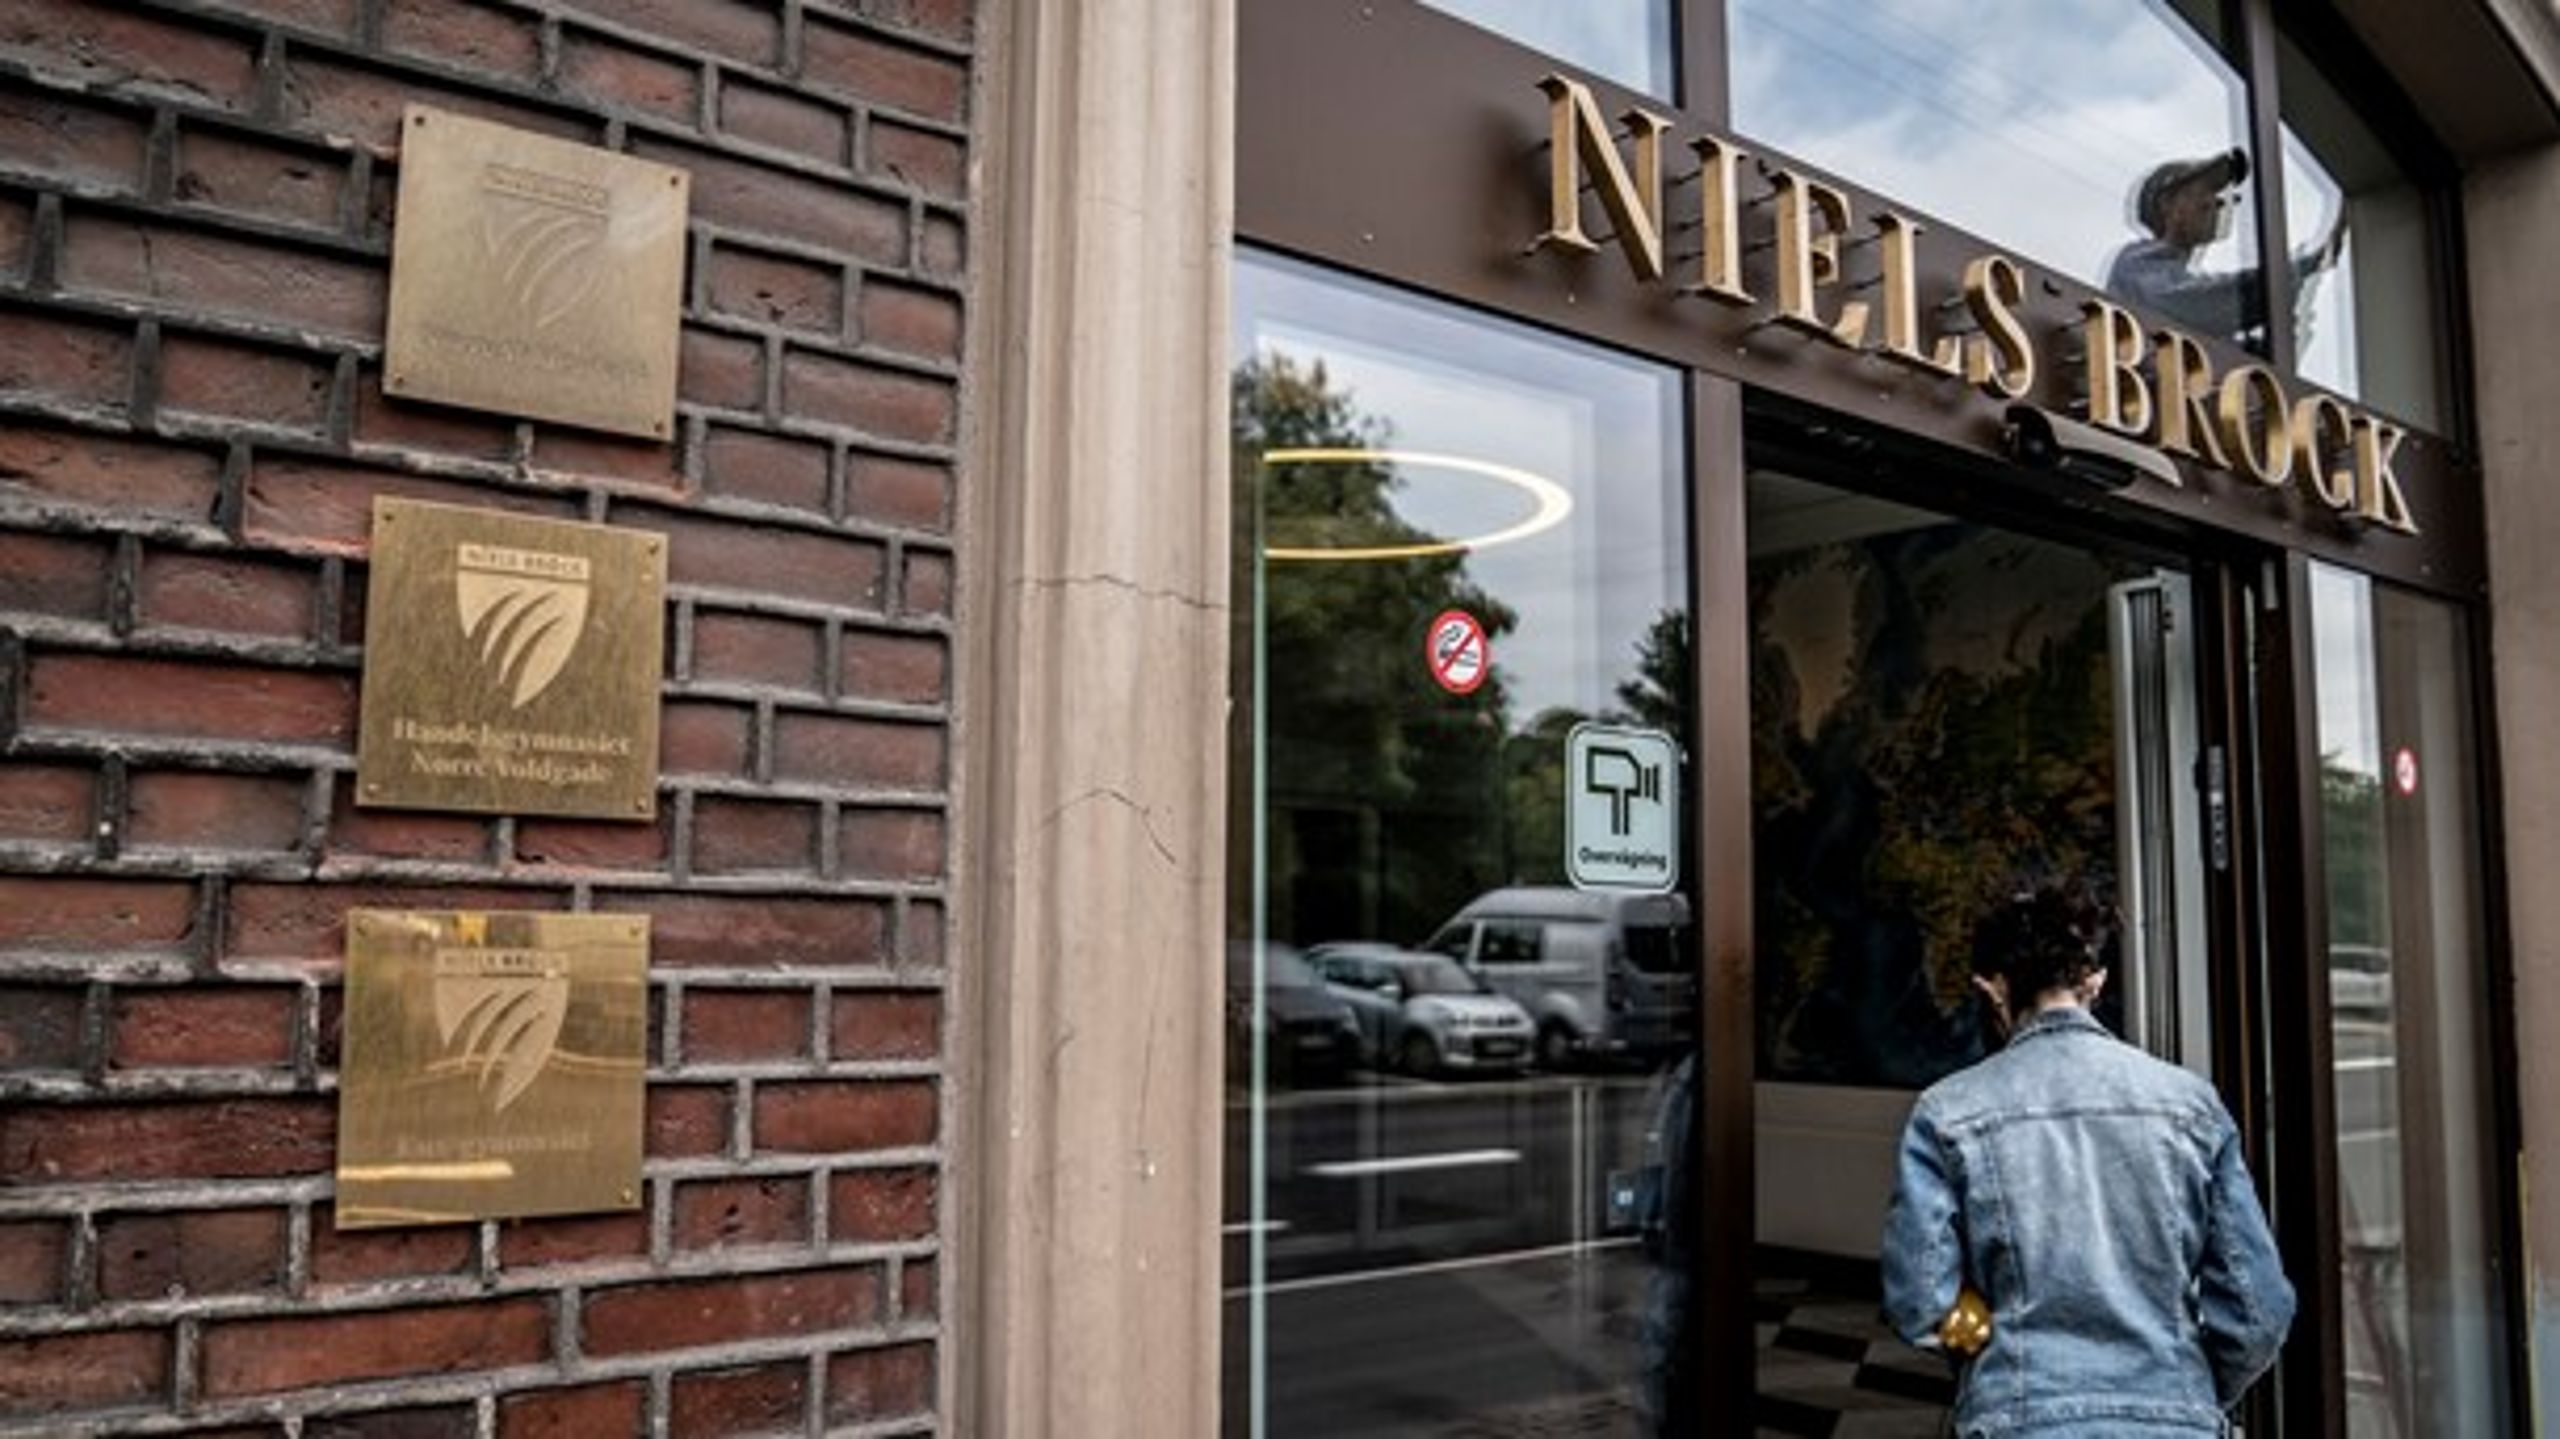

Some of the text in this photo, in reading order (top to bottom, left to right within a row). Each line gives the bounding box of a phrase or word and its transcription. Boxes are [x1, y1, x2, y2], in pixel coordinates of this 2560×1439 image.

[1534, 73, 2420, 537] NIELS BROCK
[1578, 846, 1667, 872] Overvågning
